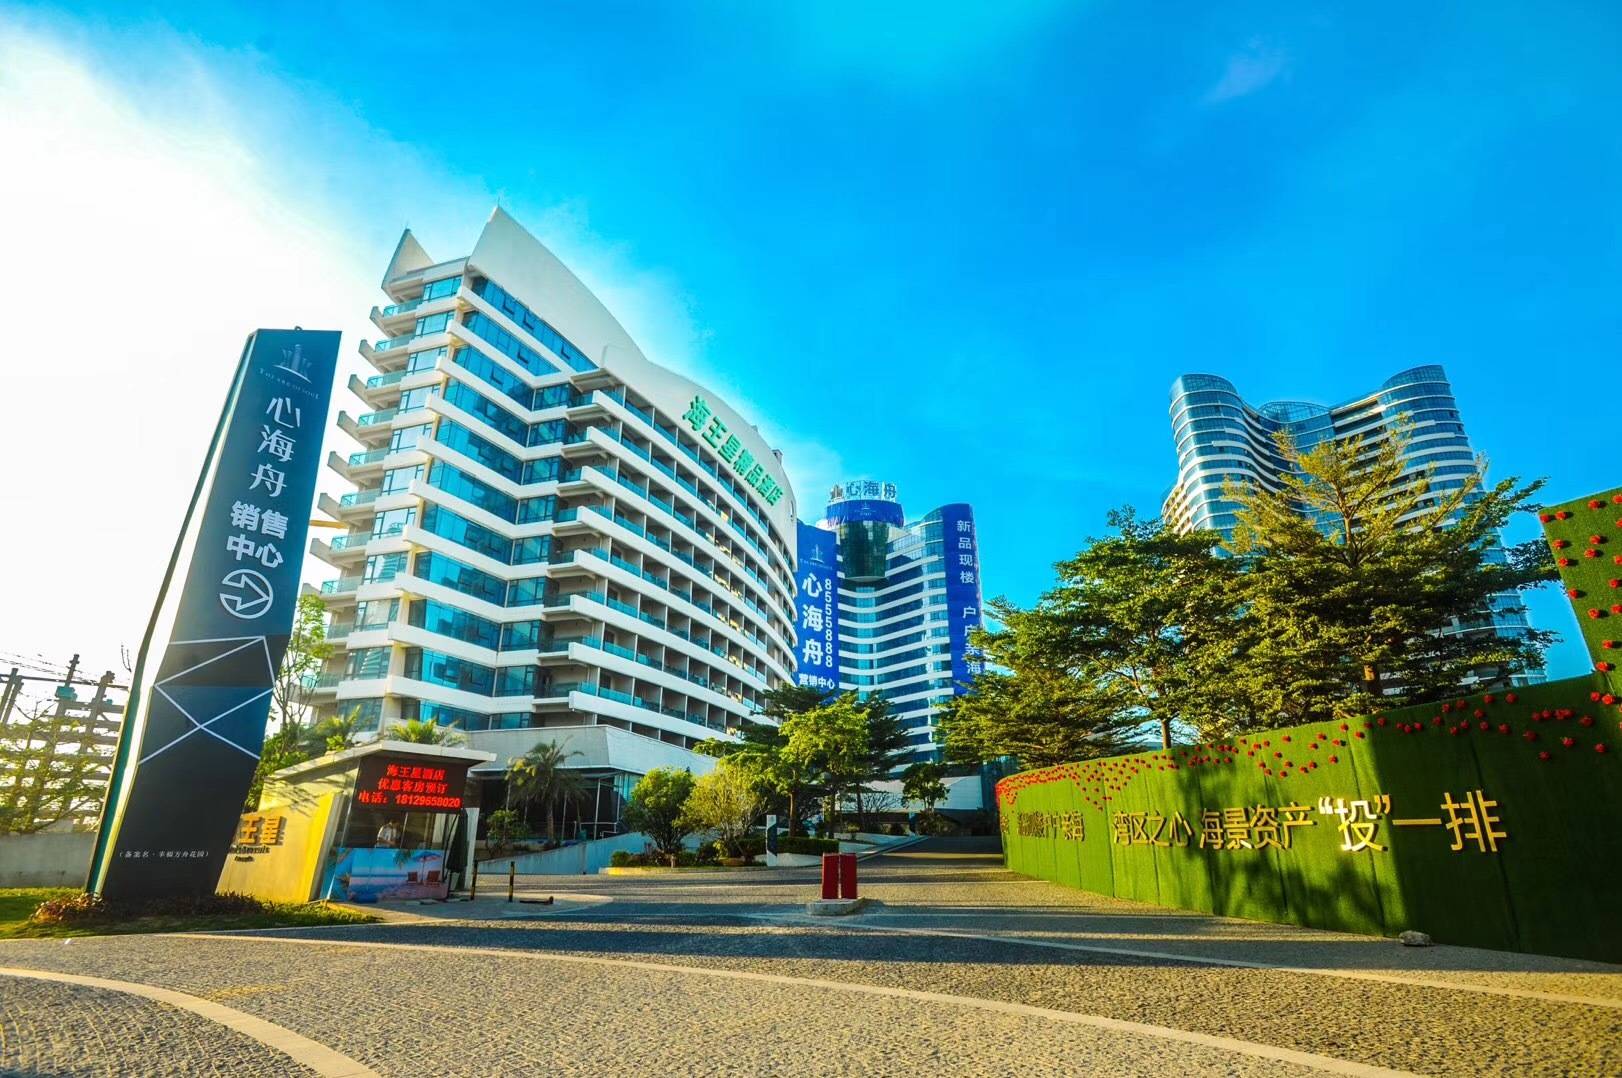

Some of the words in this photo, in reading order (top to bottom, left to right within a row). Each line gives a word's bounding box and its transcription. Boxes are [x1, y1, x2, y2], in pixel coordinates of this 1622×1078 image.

[249, 396, 301, 498] 心海舟
[682, 395, 784, 506] 海王星精品酒店
[845, 480, 897, 499] 心海舟
[229, 500, 289, 540] 销售
[226, 534, 284, 569] 中心
[956, 519, 974, 584] 新品现楼
[802, 572, 823, 665] 心海舟
[378, 777, 448, 794] 优惠客房预订
[386, 763, 446, 781] 海王星酒店
[1112, 810, 1193, 848] 湾区之心
